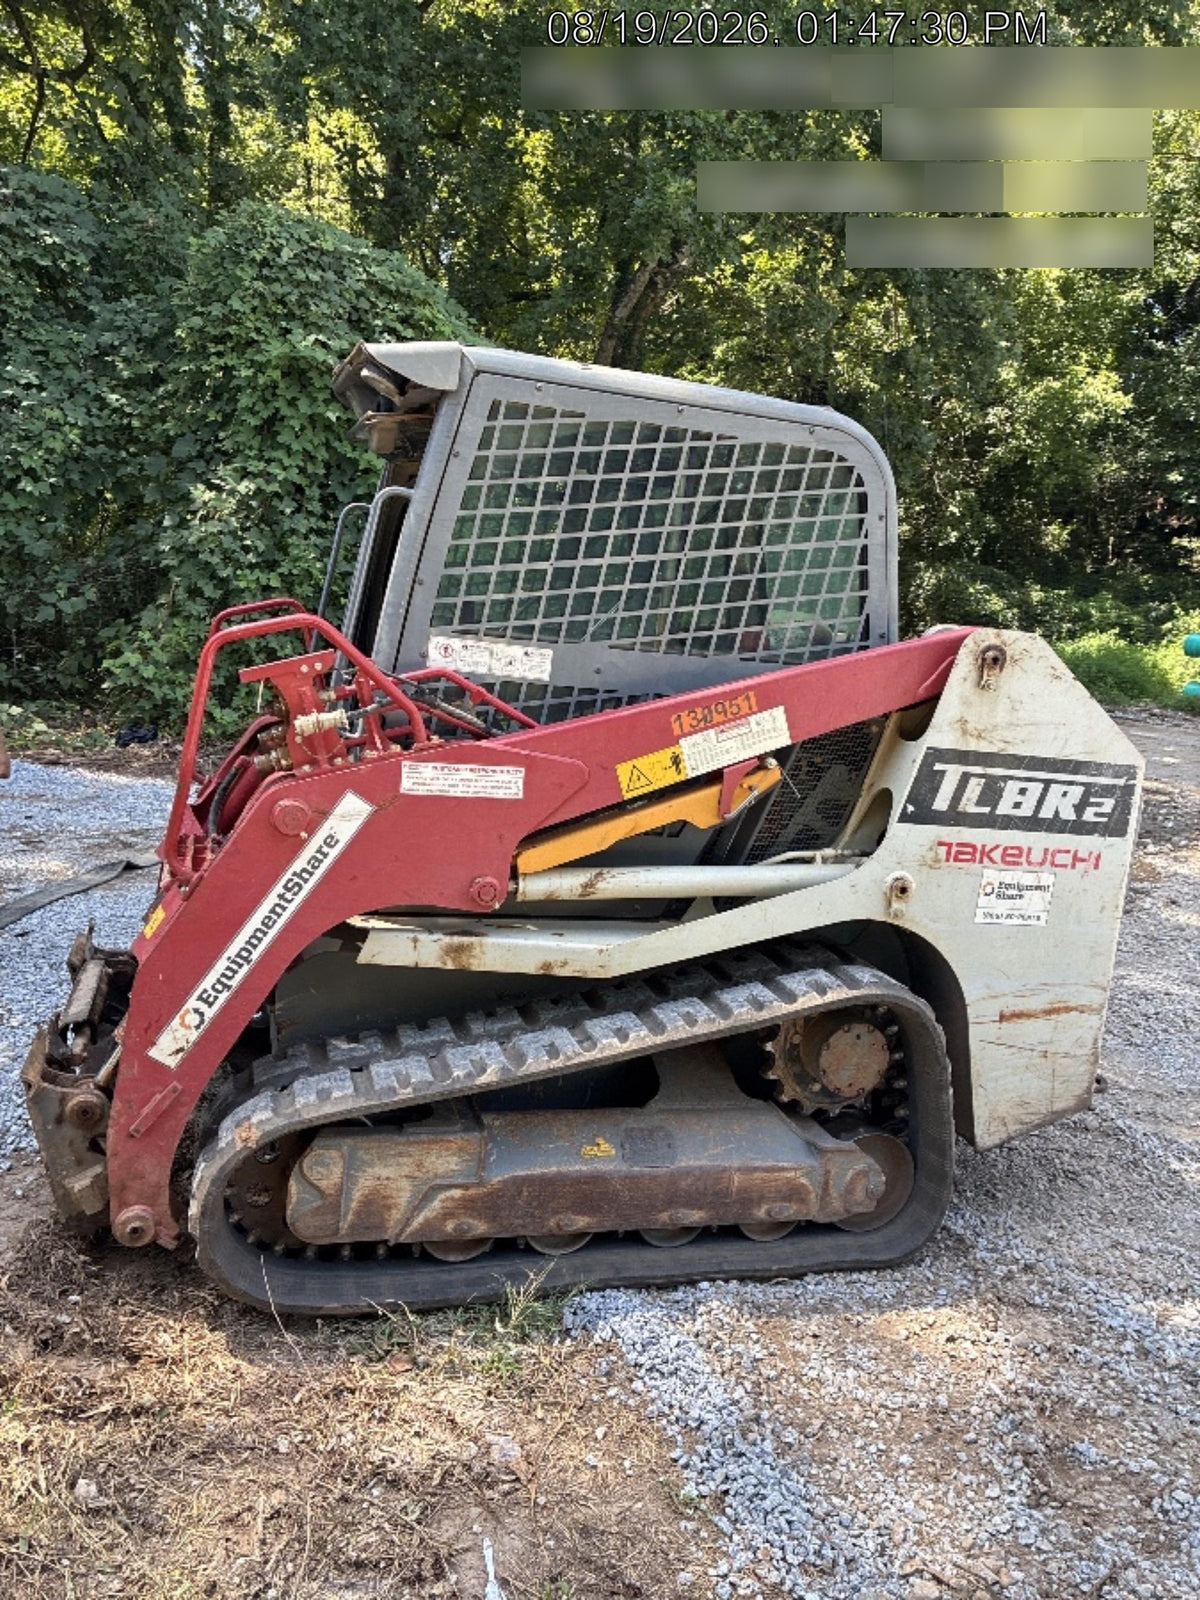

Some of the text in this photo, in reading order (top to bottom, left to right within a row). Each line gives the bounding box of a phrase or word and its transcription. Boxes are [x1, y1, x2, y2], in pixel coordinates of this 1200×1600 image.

[996, 880, 1051, 893] Equipment
[995, 890, 1025, 901] Share
[194, 832, 341, 1009] EquipmentShare
